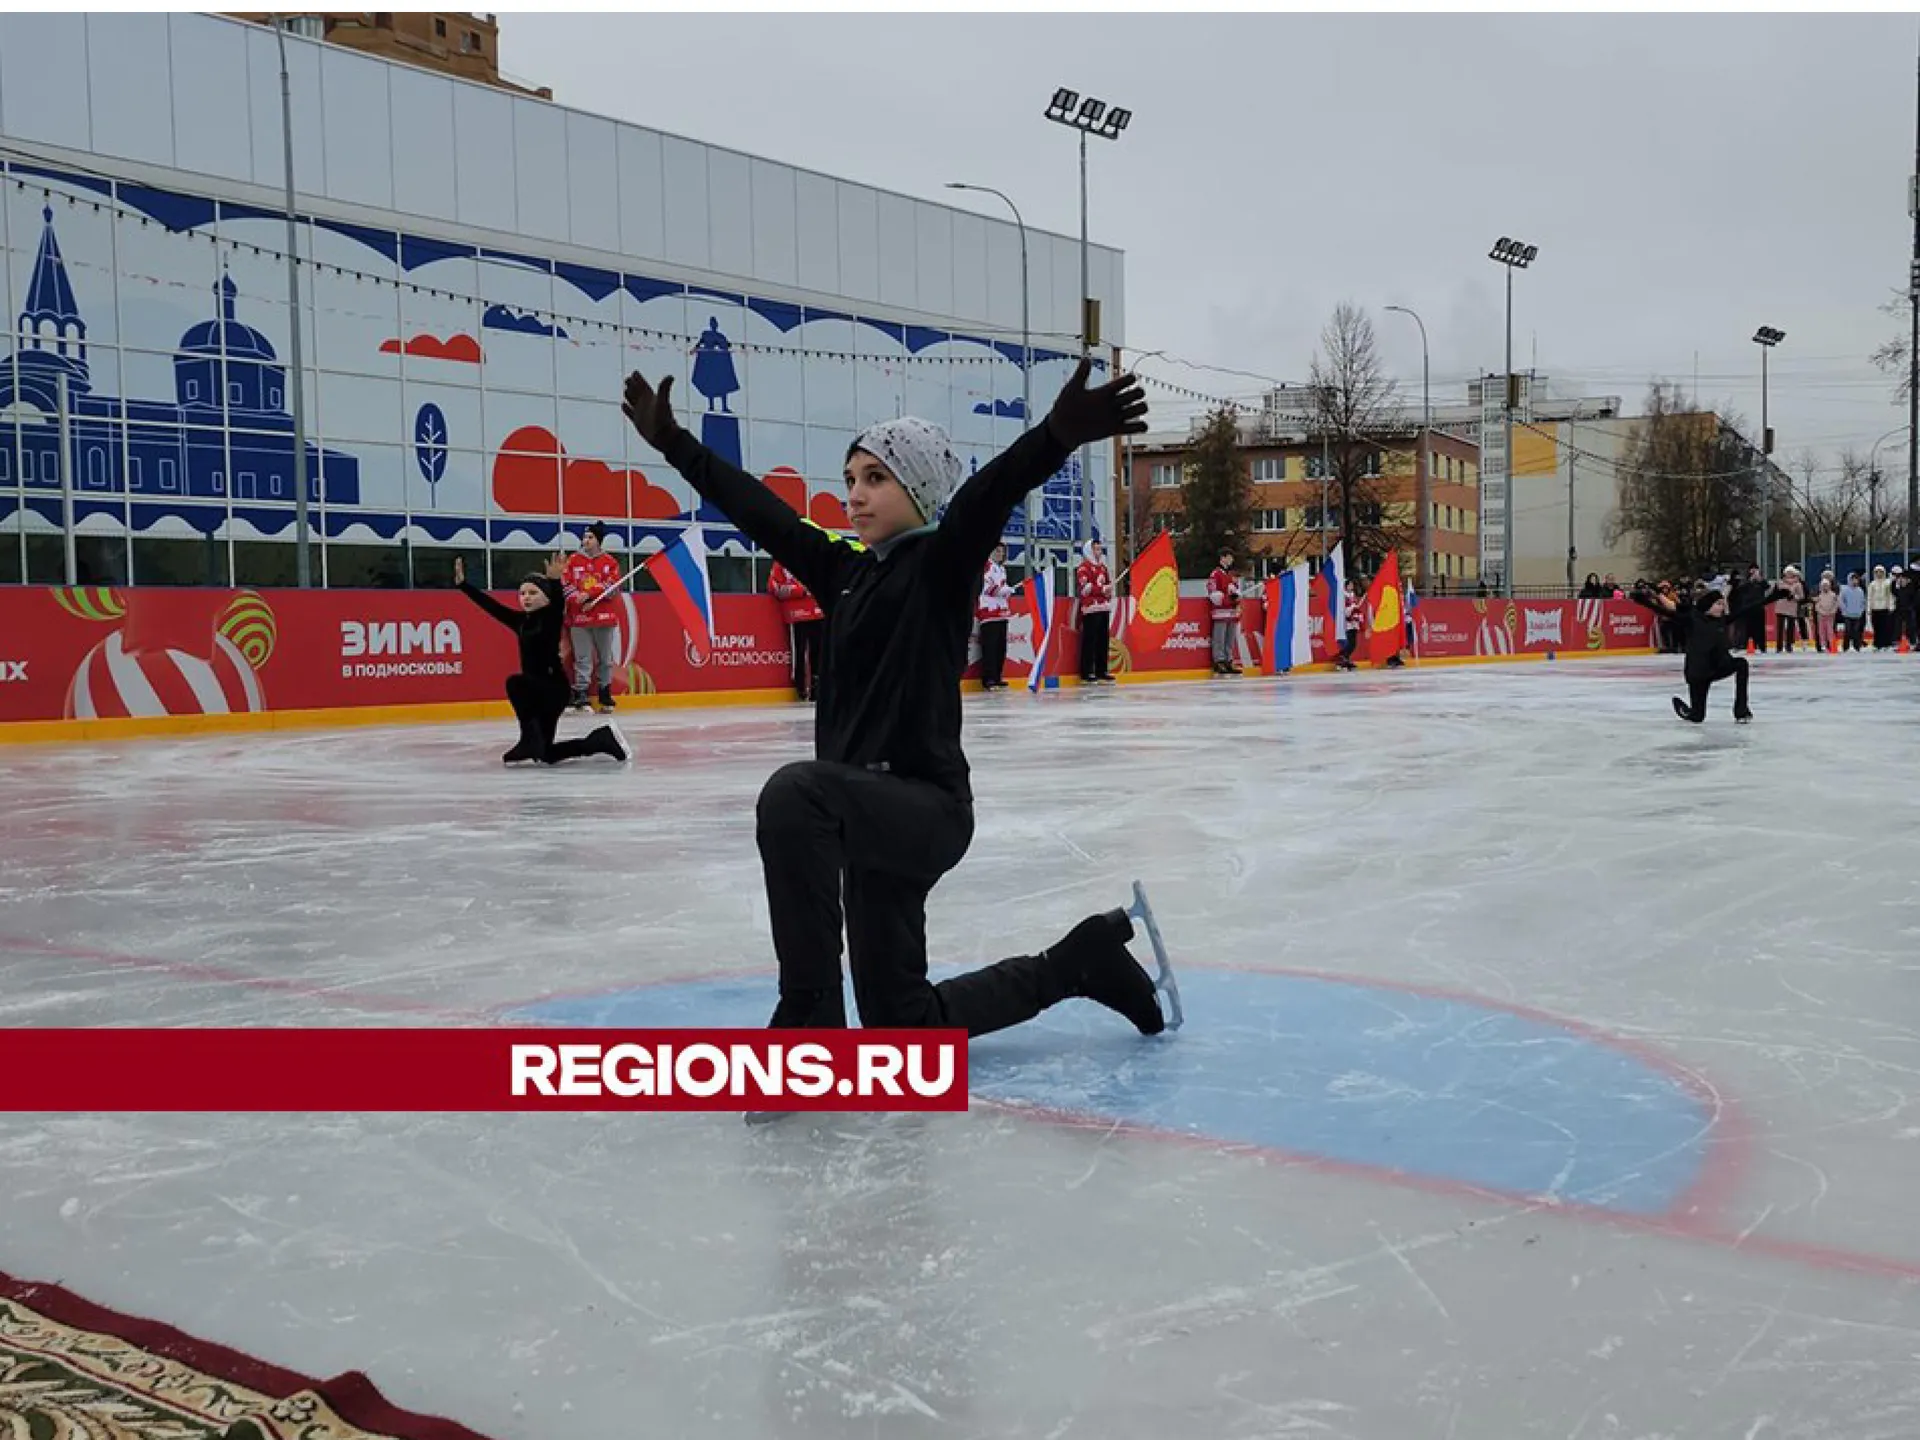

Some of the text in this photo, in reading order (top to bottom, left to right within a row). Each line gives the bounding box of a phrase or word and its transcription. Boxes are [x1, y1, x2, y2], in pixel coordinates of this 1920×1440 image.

[340, 619, 462, 656] ЗИМА
[711, 635, 755, 648] ПАРКИ
[711, 651, 792, 665] ПОДМОСКОВ
[355, 661, 463, 678] ПОДМОСКОВЬЕ
